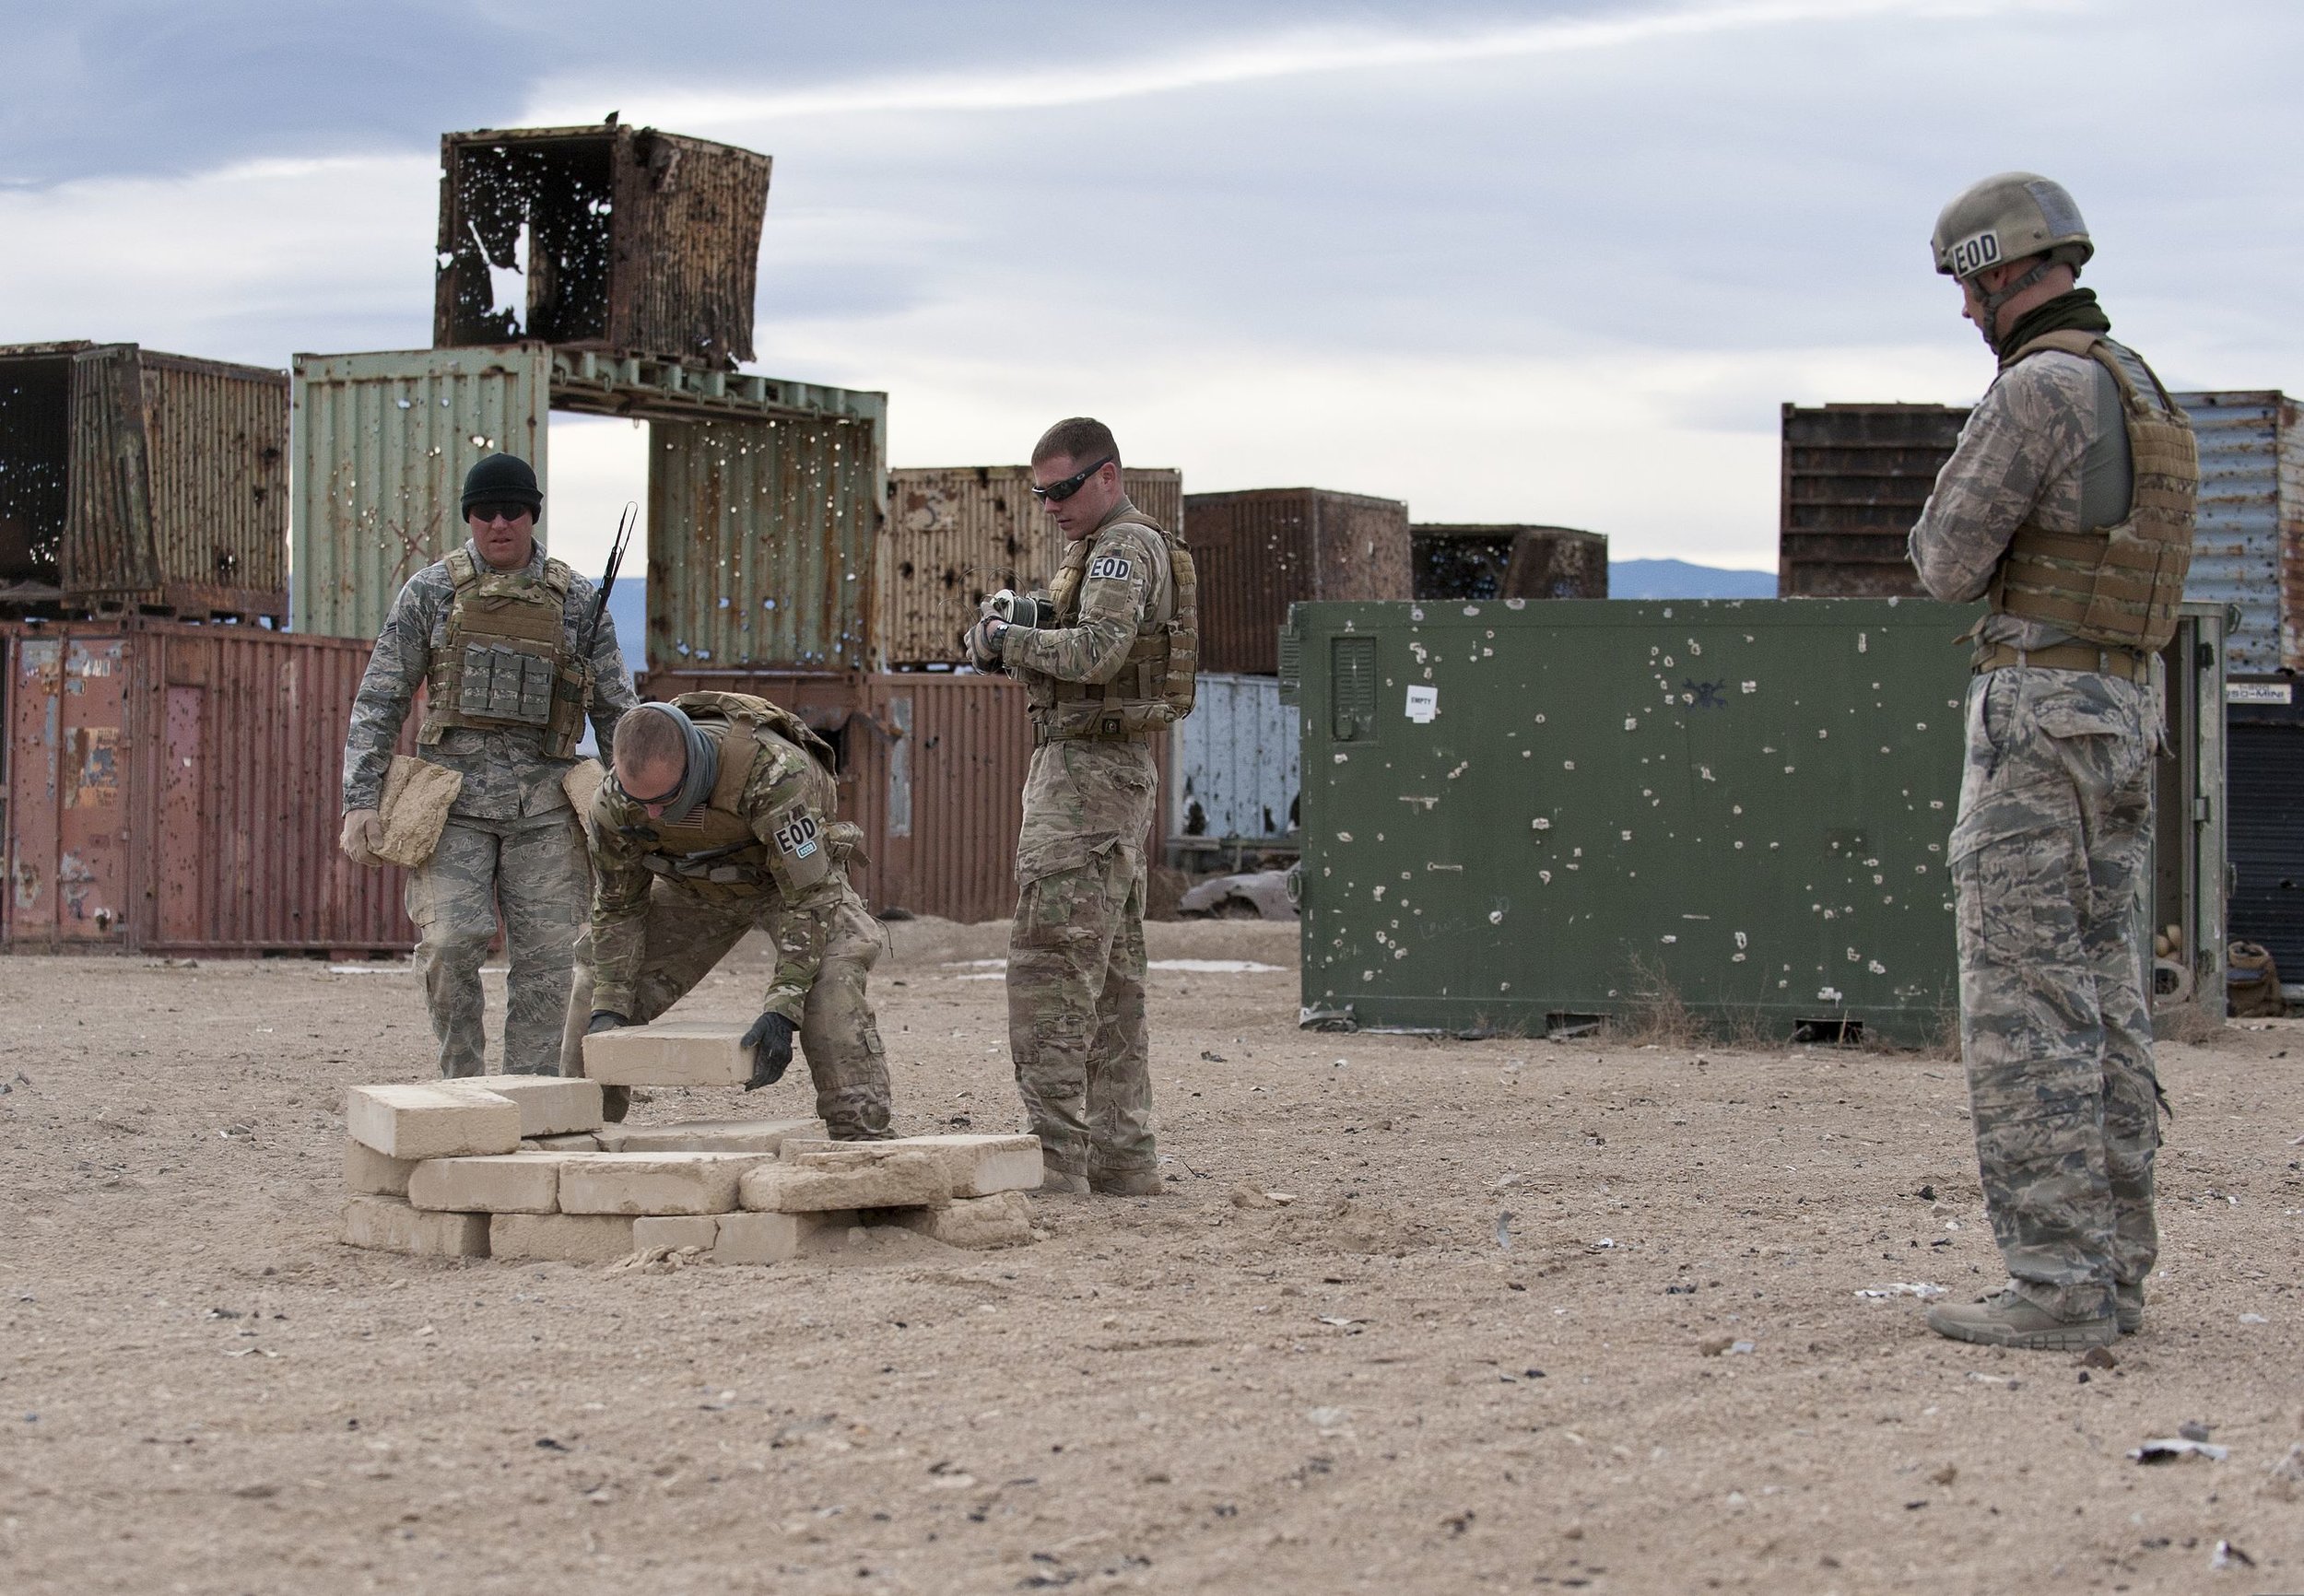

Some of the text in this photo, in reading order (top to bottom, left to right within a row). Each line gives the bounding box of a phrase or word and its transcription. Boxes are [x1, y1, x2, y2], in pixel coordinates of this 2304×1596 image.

[1955, 234, 1997, 275] EOD
[1090, 558, 1129, 578] EOD
[1411, 697, 1431, 705] EMPTY
[776, 817, 816, 853] EOD
